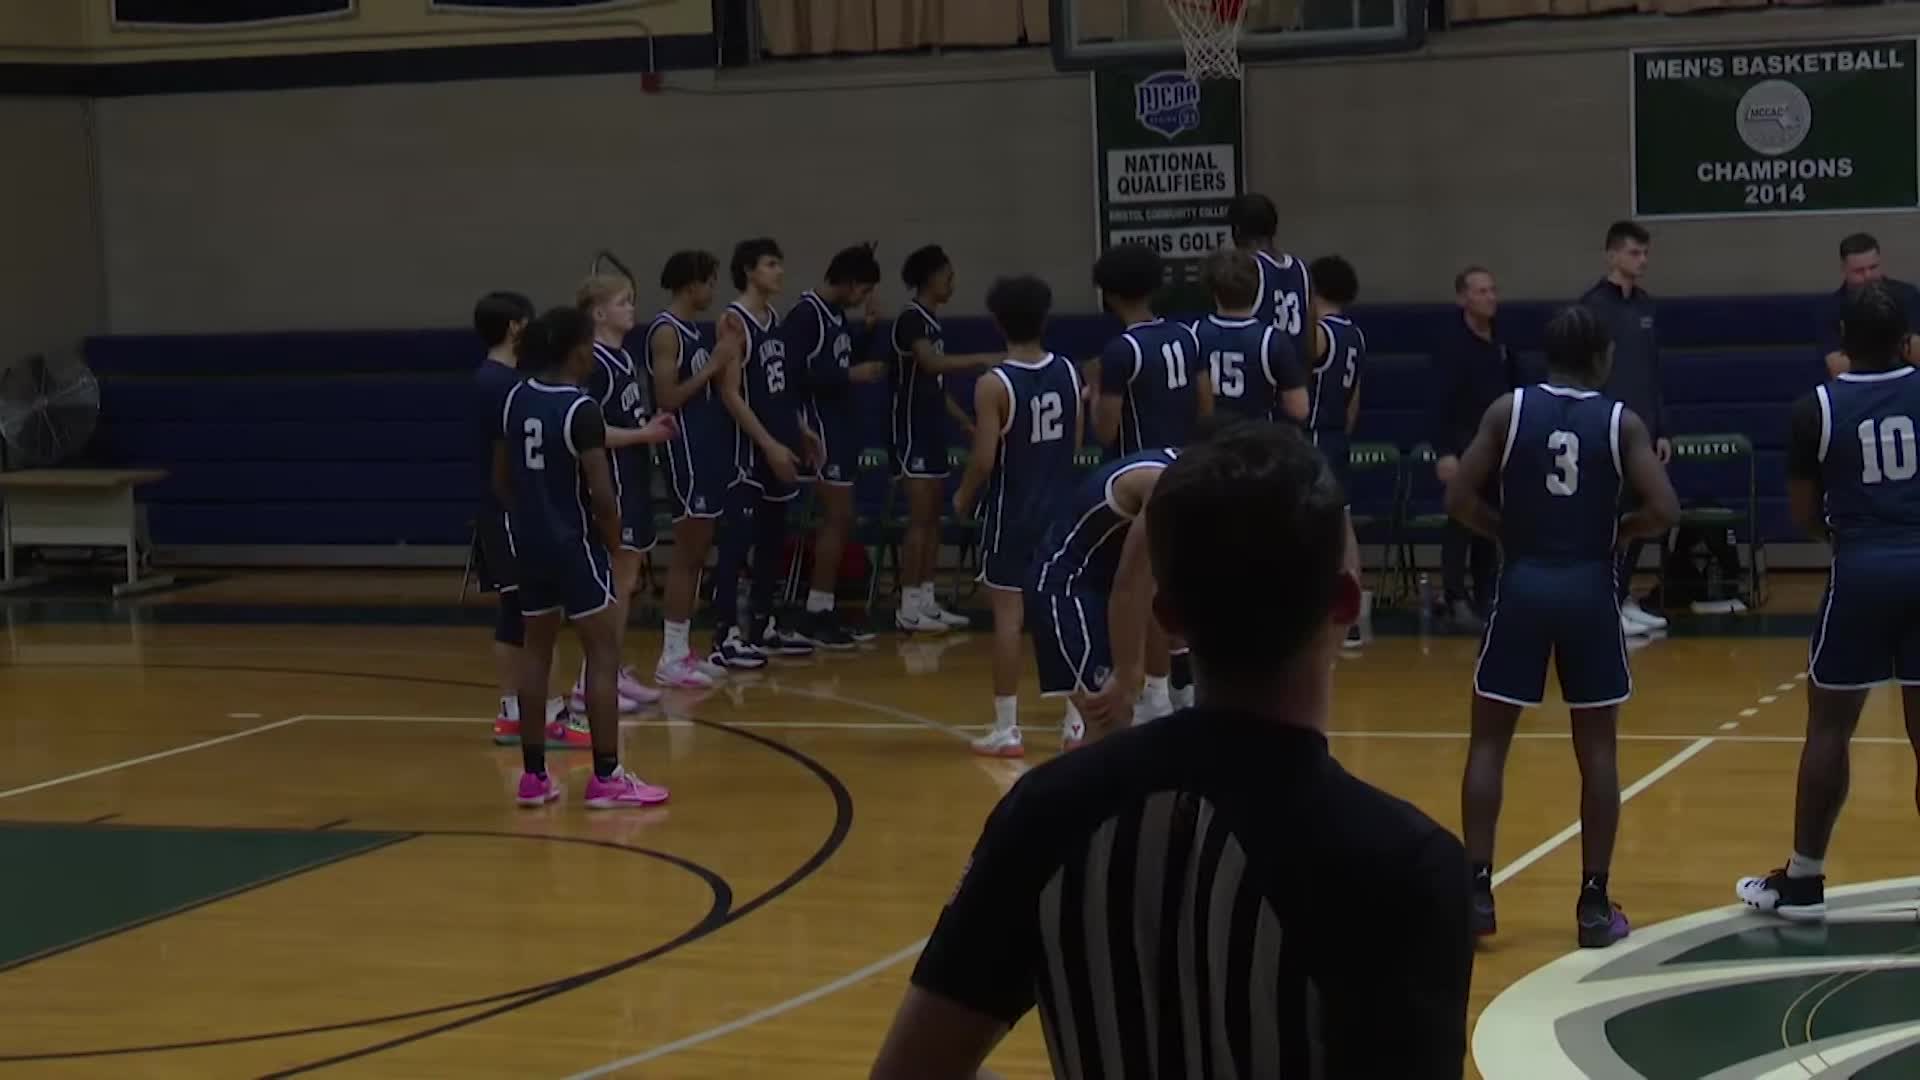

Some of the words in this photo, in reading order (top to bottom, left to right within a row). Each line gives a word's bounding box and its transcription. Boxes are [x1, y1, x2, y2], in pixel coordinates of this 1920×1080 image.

[1646, 56, 1725, 80] MEN'S
[1732, 49, 1905, 77] BASKETBALL
[1118, 171, 1226, 195] QUALIFIERS
[1125, 152, 1218, 174] NATIONAL
[1696, 157, 1854, 183] CHAMPIONS
[1744, 183, 1807, 205] 2014
[1180, 231, 1226, 252] GOLF
[1273, 289, 1301, 336] 33
[1161, 339, 1188, 390] 11
[1209, 351, 1246, 398] 15
[1342, 347, 1358, 388] 5
[1030, 391, 1064, 443] 12
[524, 417, 546, 470] 2
[1545, 430, 1580, 496] 3
[1677, 443, 1738, 456] BRISTOL
[1857, 415, 1918, 484] 10
